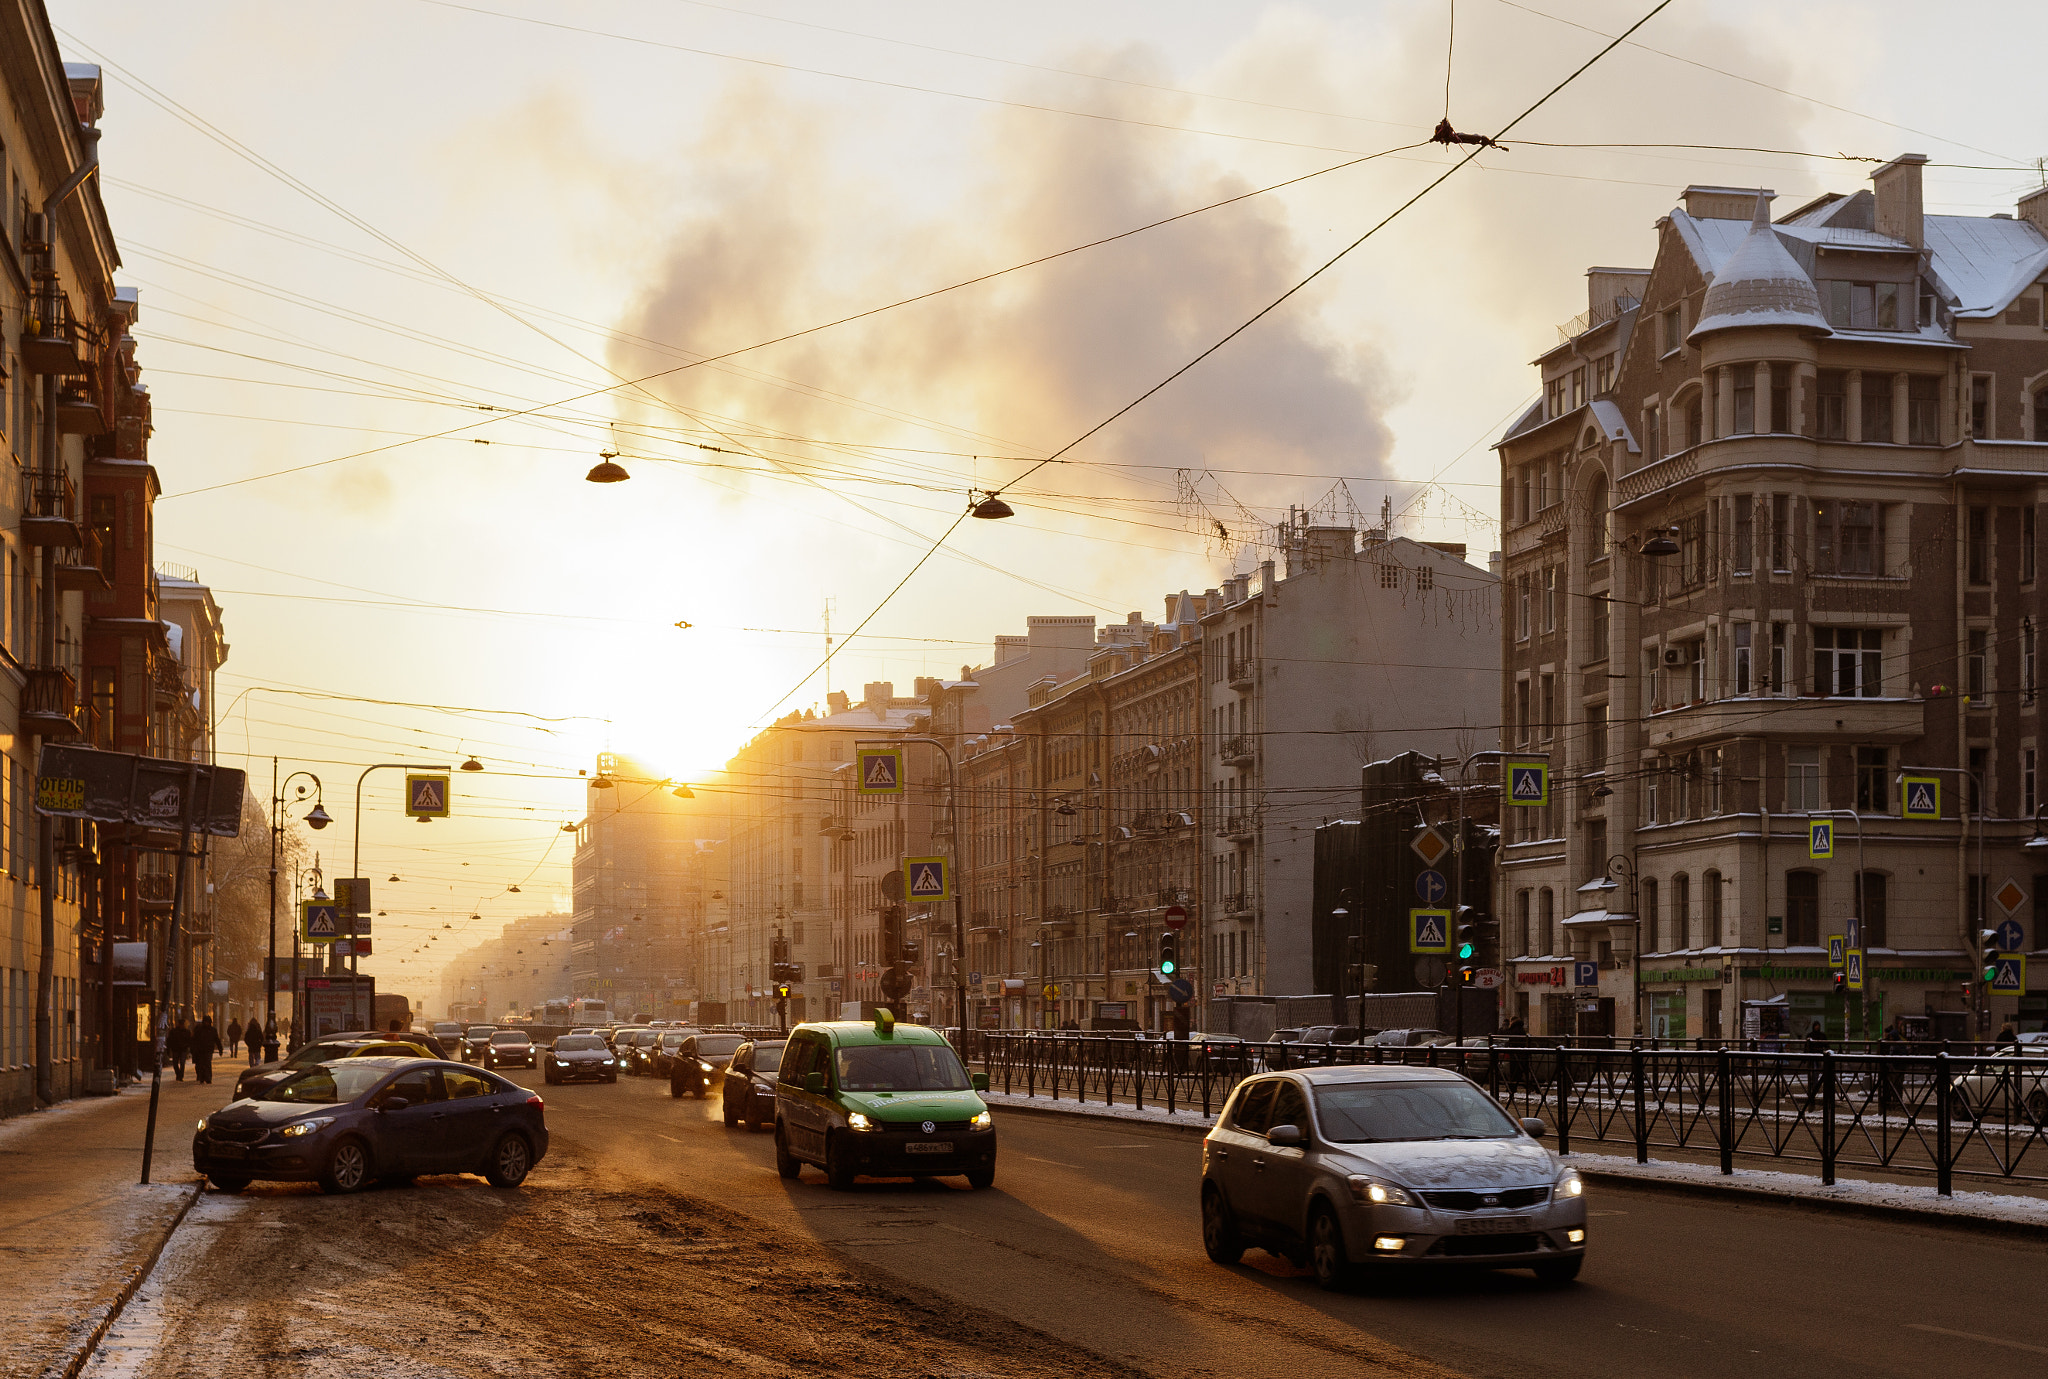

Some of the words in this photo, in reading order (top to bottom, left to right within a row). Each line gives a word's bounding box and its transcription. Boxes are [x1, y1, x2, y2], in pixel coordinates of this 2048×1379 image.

[40, 778, 84, 793] ОТЕЛЬ
[39, 796, 83, 809] 925-15-15
[1550, 966, 1566, 986] 24
